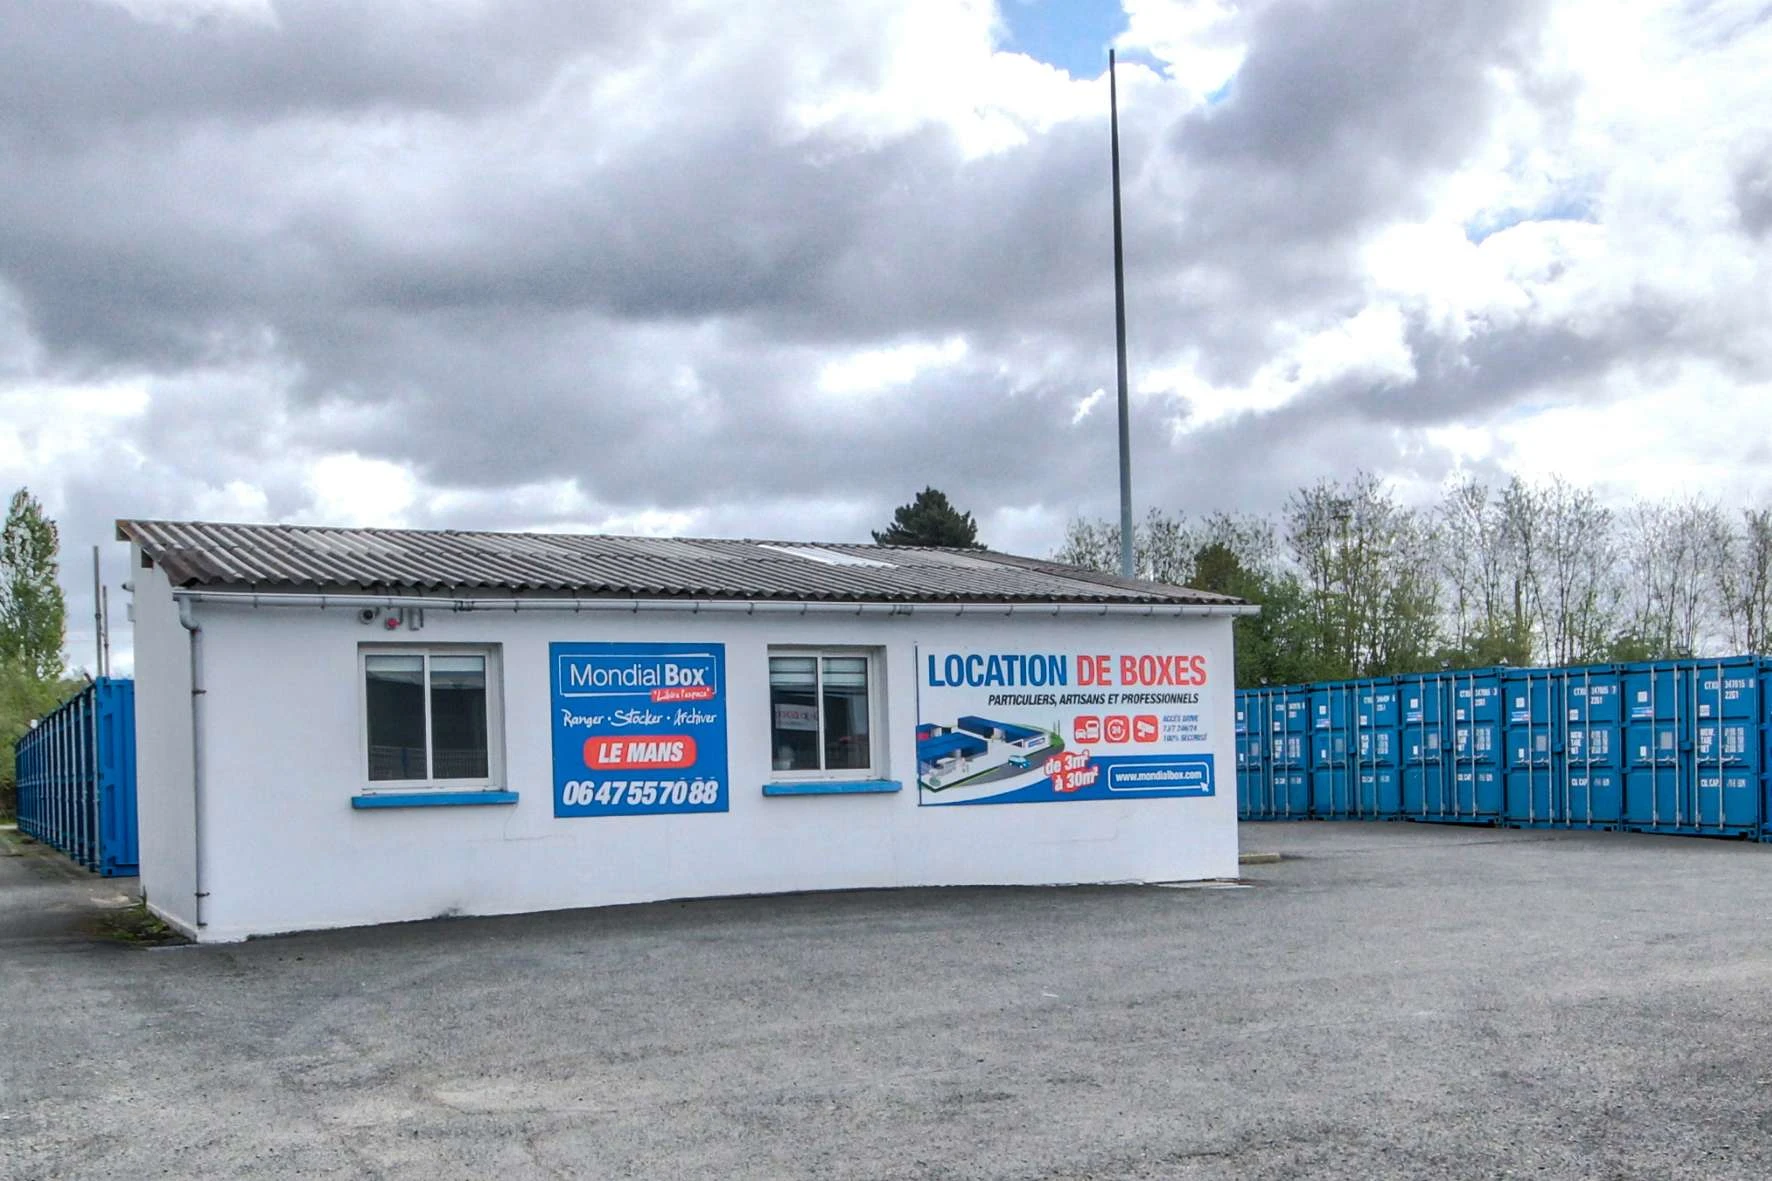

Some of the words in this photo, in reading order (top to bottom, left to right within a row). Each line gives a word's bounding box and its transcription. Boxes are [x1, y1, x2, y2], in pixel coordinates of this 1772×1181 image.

[928, 653, 1068, 687] LOCATION
[1077, 655, 1113, 686] DE
[1120, 655, 1207, 686] BOXES
[988, 693, 1057, 707] PARTICULIERS,
[1059, 693, 1105, 705] ARTISANS
[1107, 693, 1119, 705] ET
[1121, 693, 1199, 705] PROFESSIONNELS
[561, 708, 604, 728] Ranger
[611, 708, 663, 727] Stocker
[673, 708, 717, 726] Archiver
[598, 743, 623, 763] LE
[626, 741, 684, 762] MANS
[1045, 758, 1062, 774] de
[1115, 770, 1202, 782] www.mondialbox.com
